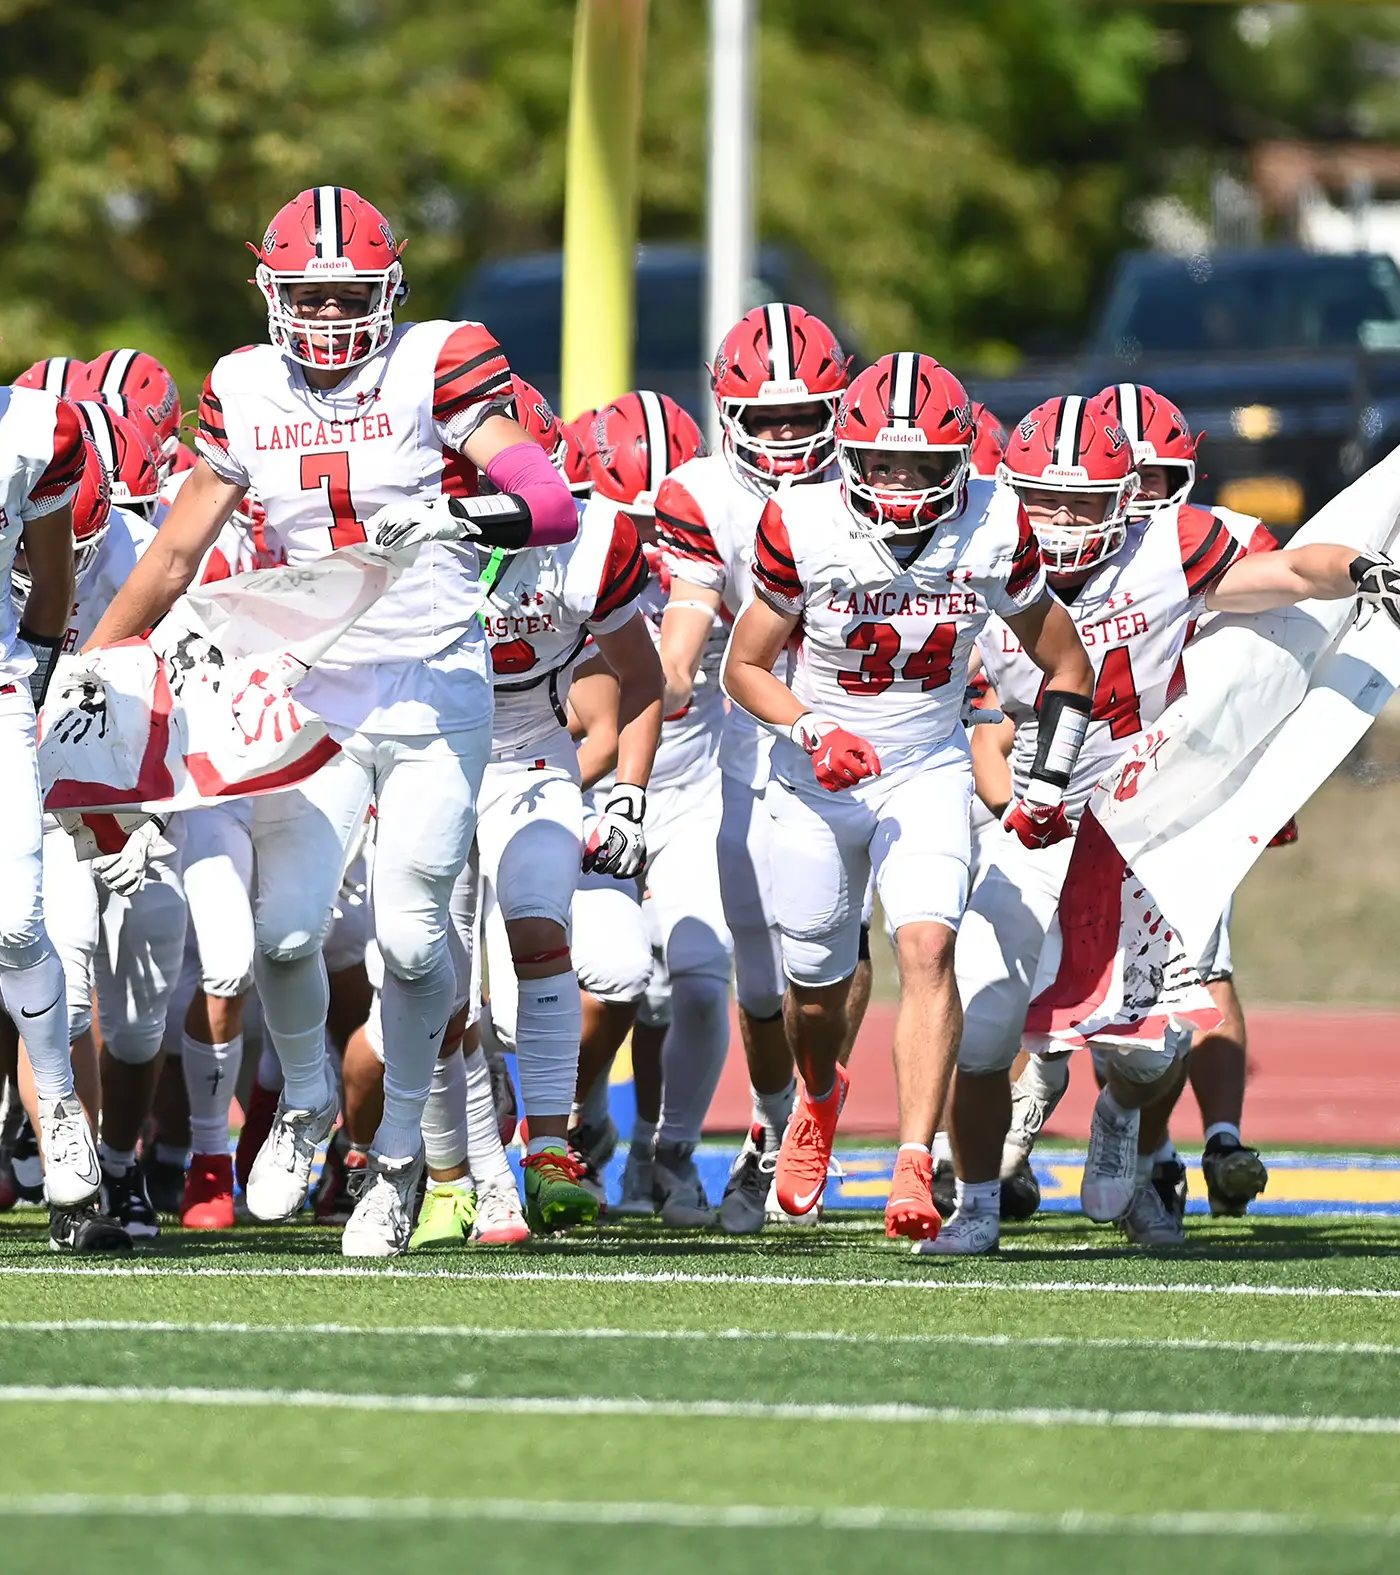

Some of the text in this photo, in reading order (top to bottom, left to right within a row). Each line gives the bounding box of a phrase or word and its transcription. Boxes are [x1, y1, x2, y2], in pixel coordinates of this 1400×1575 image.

[311, 261, 348, 269] Riddell
[254, 412, 393, 451] LANCASTER
[881, 433, 922, 443] Riddell
[300, 450, 368, 551] 7
[827, 589, 977, 616] LANCASTER
[484, 613, 558, 638] ASTER
[836, 621, 958, 697] 34
